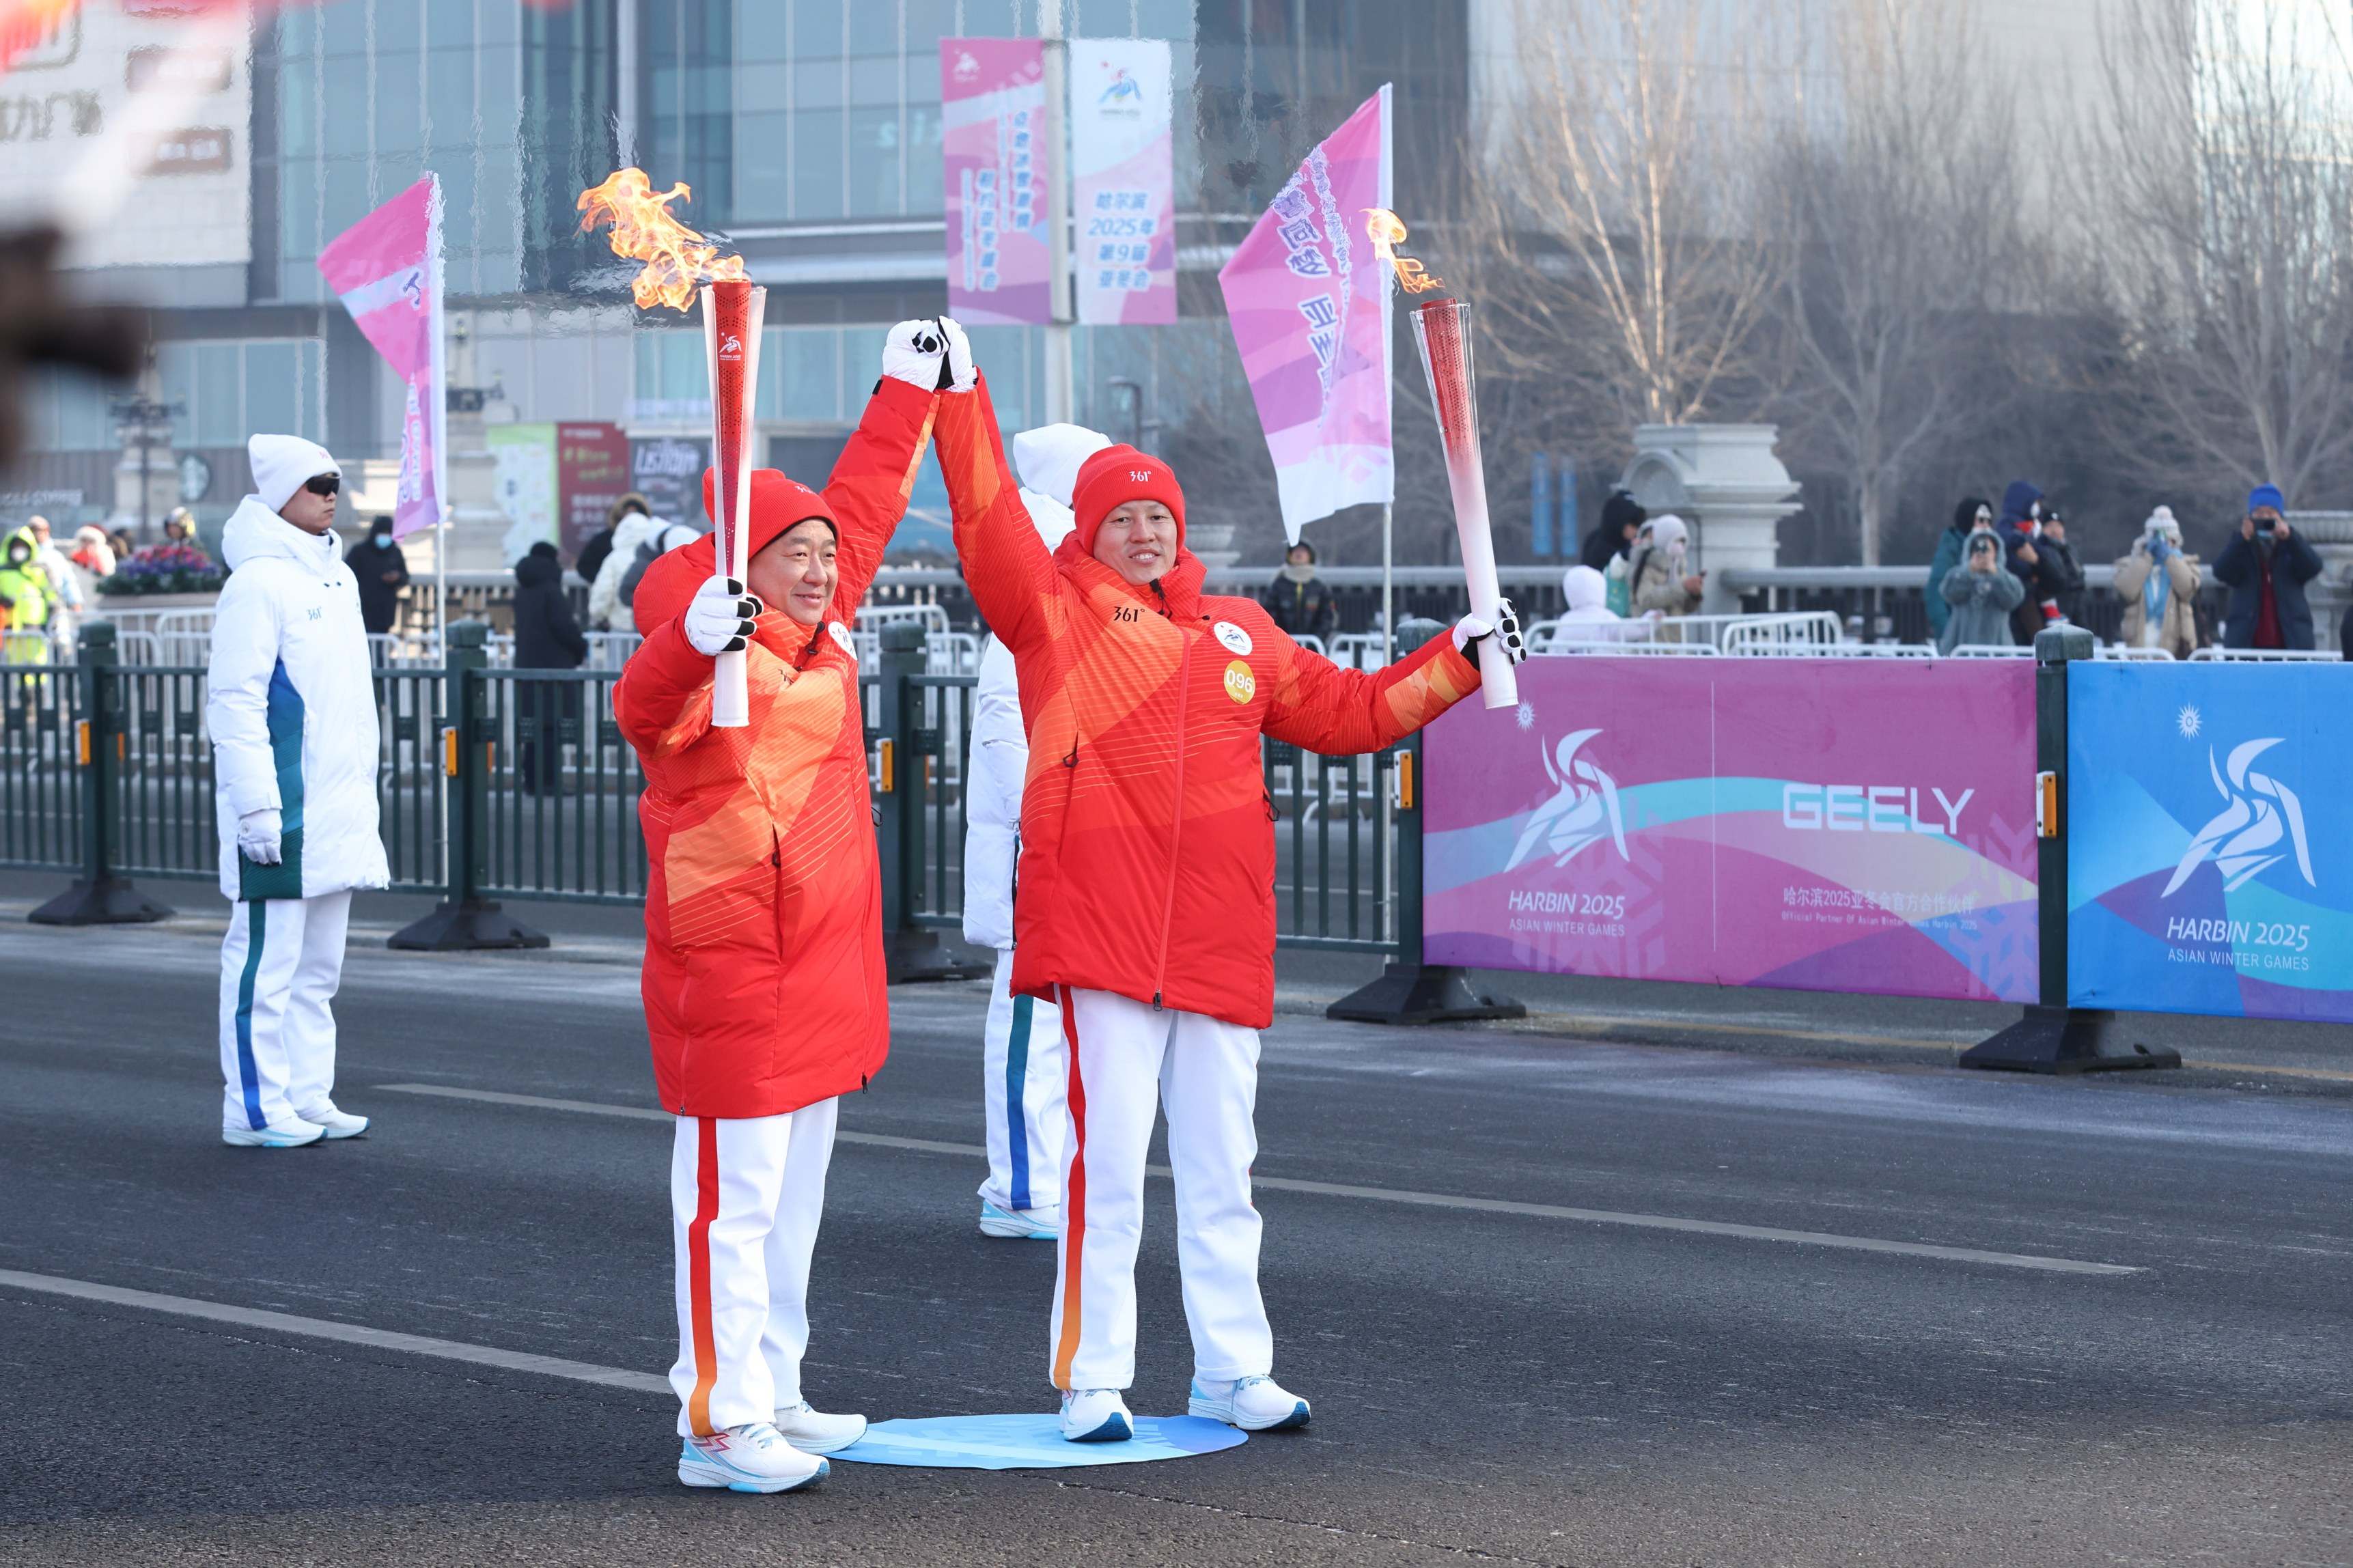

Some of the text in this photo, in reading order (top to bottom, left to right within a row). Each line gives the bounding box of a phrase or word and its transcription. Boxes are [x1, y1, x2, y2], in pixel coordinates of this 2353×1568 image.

[1096, 193, 1148, 211] 哈尔滨
[1099, 270, 1149, 288] 亚冬会
[1226, 669, 1253, 692] 096
[1783, 784, 1975, 835] GEELY
[1508, 890, 1626, 920] HARBIN 2025
[1783, 886, 1975, 914] 哈尔滨2025亚冬会官方合作伙伴
[1509, 919, 1625, 937] ASIAN WINTER GAMES
[1781, 911, 1811, 922] Official
[1816, 912, 1843, 923] Partner
[1858, 914, 1878, 925] Asian
[1882, 916, 1904, 926] Winter
[1932, 919, 1958, 929] Harbin
[1961, 920, 1977, 929] 2025
[2167, 916, 2310, 952] HARBIN 2025
[2168, 948, 2309, 970] ASIAN WINTER GAMES
